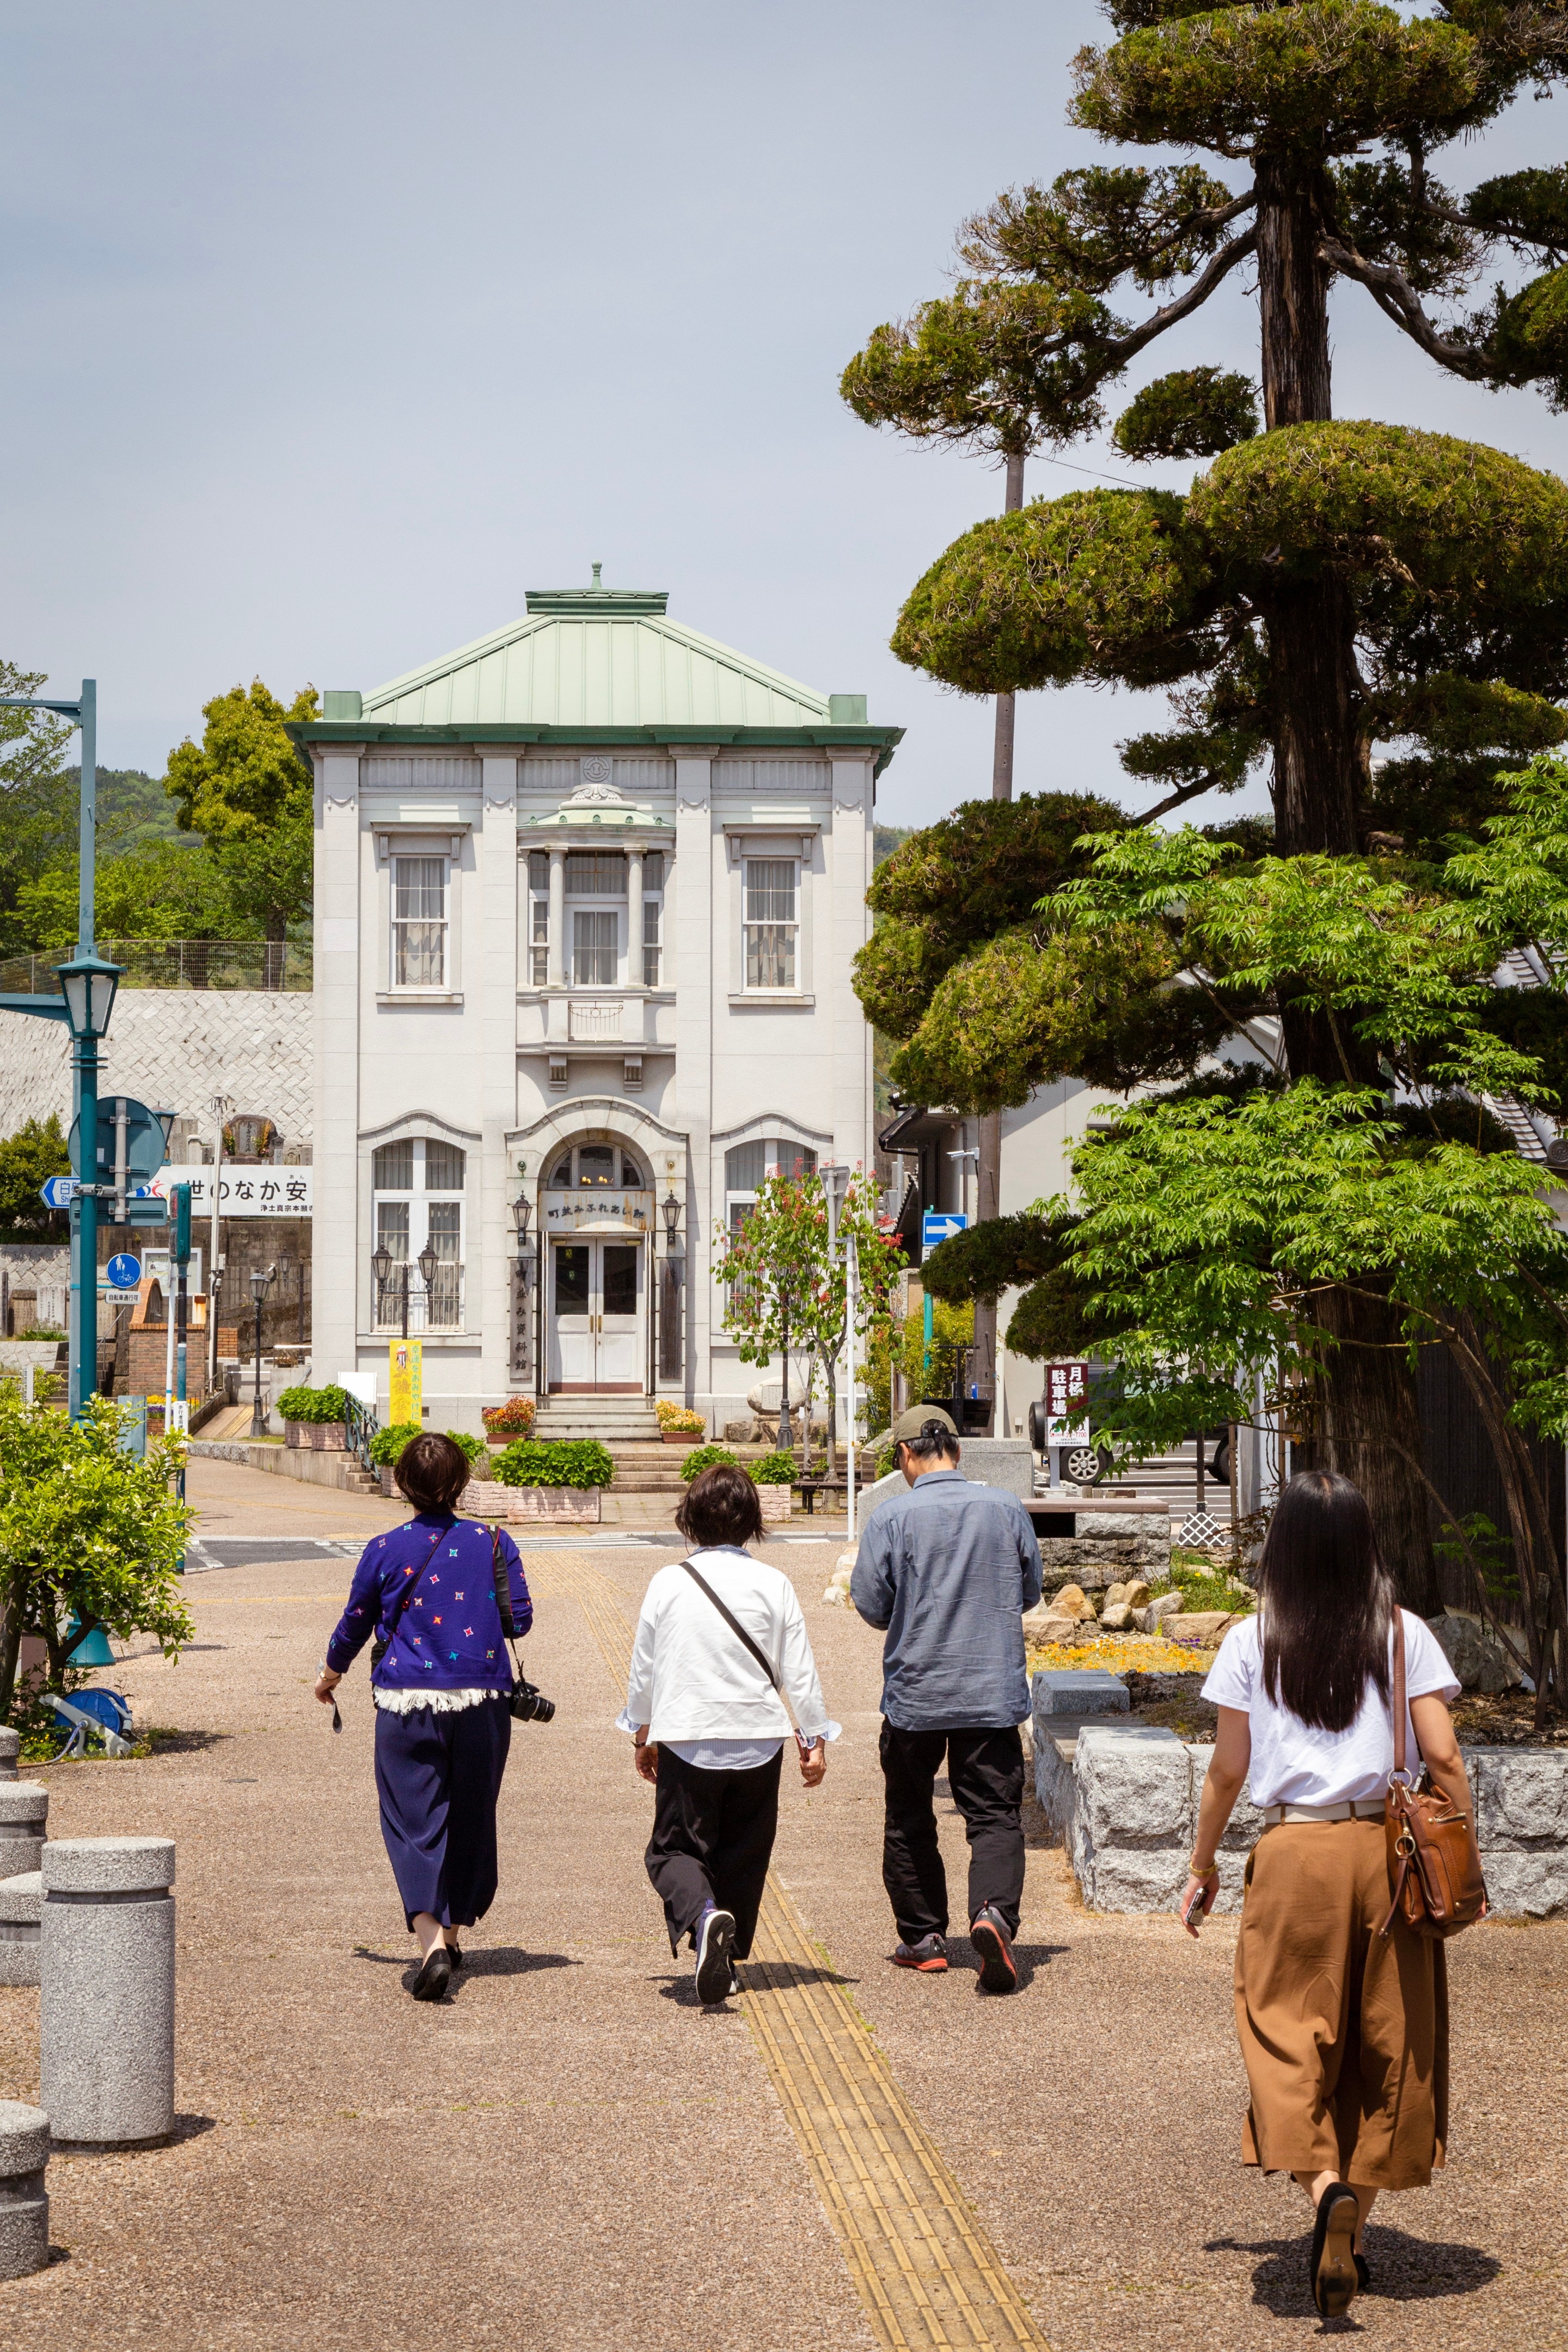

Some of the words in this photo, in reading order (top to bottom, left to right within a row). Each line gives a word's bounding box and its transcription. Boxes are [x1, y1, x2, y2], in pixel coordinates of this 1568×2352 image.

[186, 1179, 308, 1202] 世のなか安
[515, 1270, 527, 1370] 町並み資料館
[1051, 1369, 1067, 1415] 駐車場
[1069, 1367, 1084, 1396] 月極
